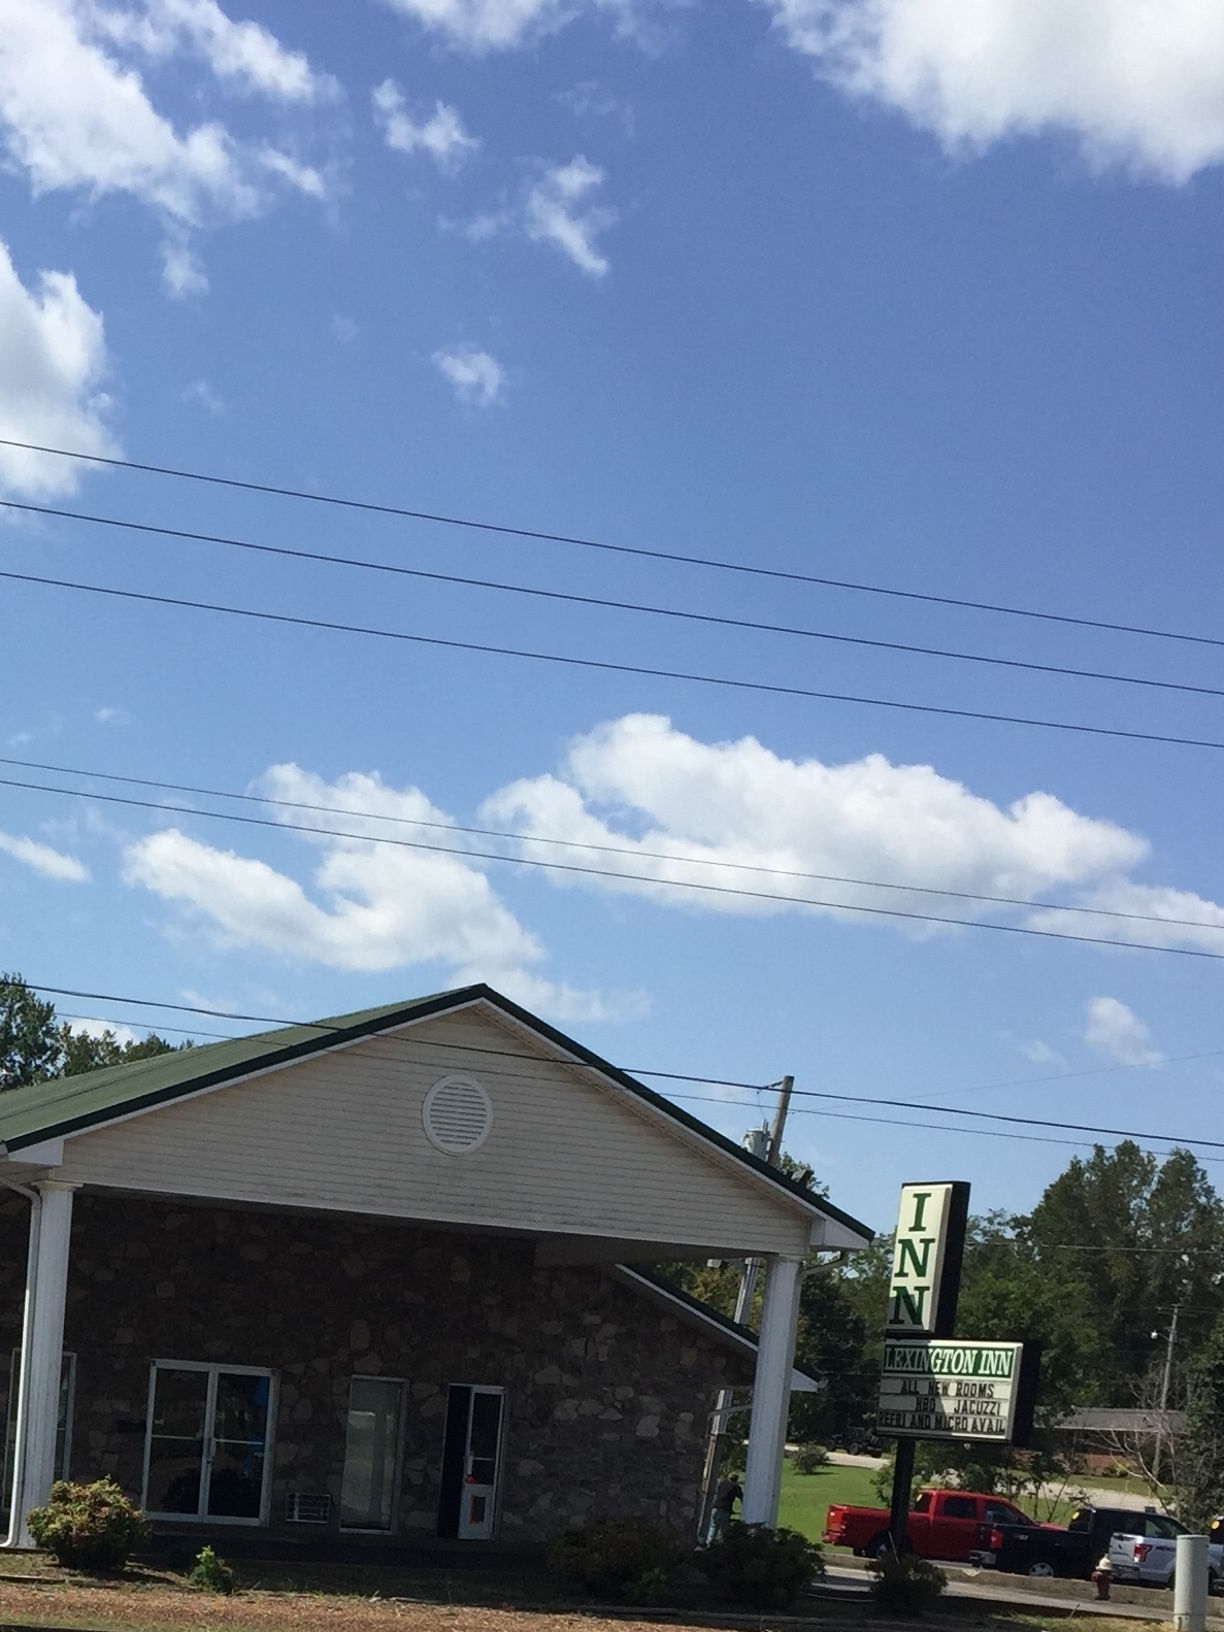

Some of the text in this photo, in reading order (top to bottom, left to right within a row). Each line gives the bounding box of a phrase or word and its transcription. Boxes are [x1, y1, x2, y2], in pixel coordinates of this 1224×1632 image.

[889, 1193, 935, 1325] INN
[885, 1347, 1013, 1375] LEXINGTON INN
[900, 1380, 995, 1398] ALL NEW ROOMS
[916, 1397, 1001, 1416] HBO JACUZZI
[879, 1411, 1005, 1433] REFRI AND MICRO AVAIL
